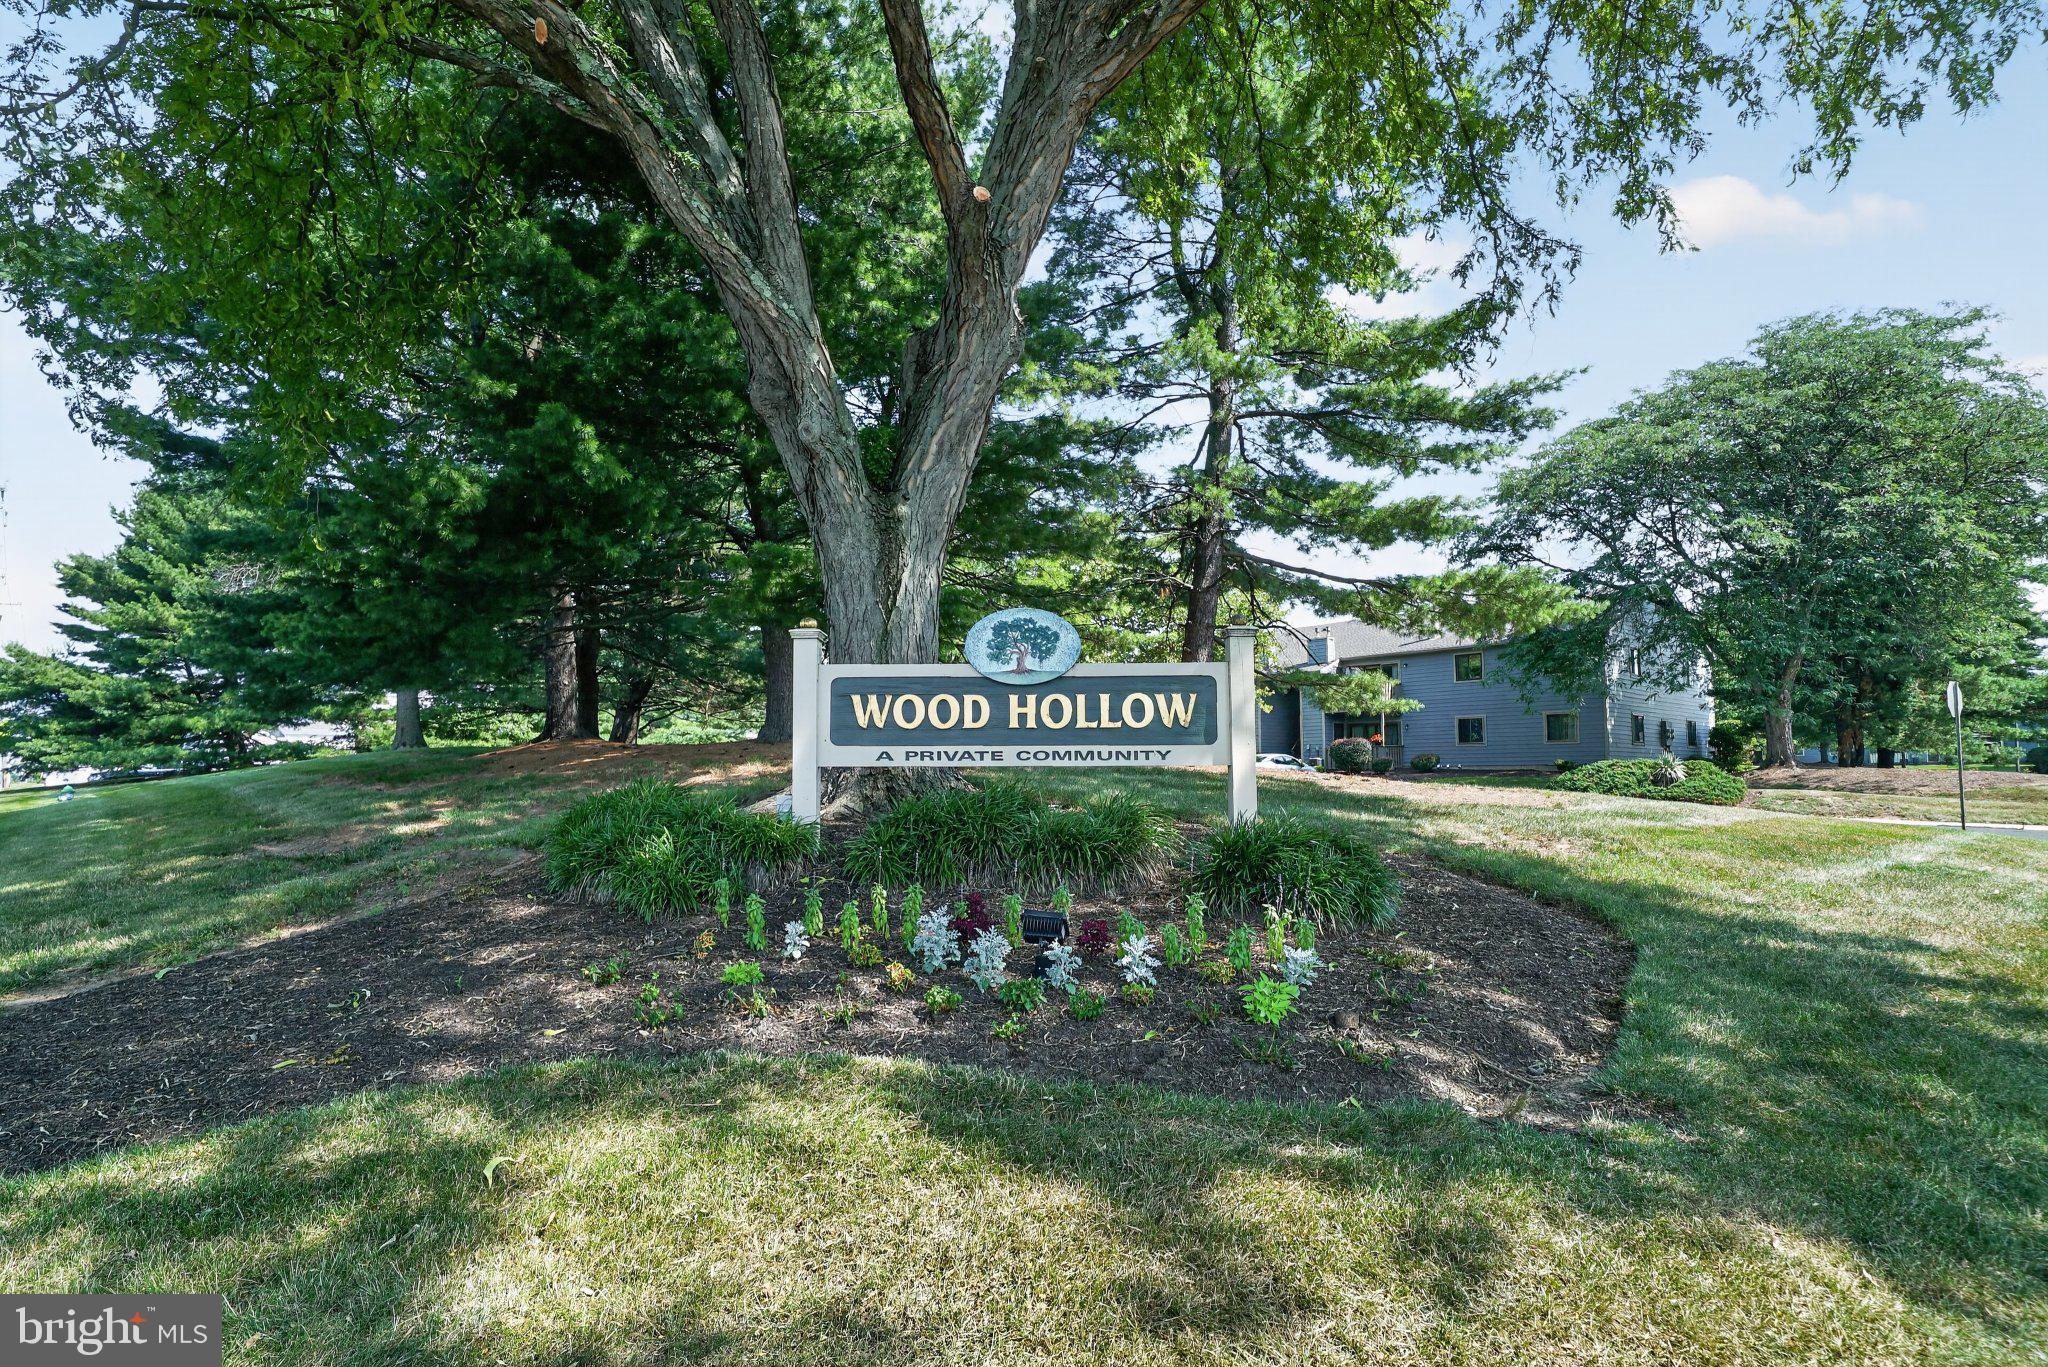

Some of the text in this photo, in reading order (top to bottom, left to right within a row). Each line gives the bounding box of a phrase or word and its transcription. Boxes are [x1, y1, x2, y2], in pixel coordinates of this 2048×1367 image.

[850, 691, 1198, 730] WOOD HOLLOW
[875, 749, 1172, 762] A PRIVATE COMMUNITY
